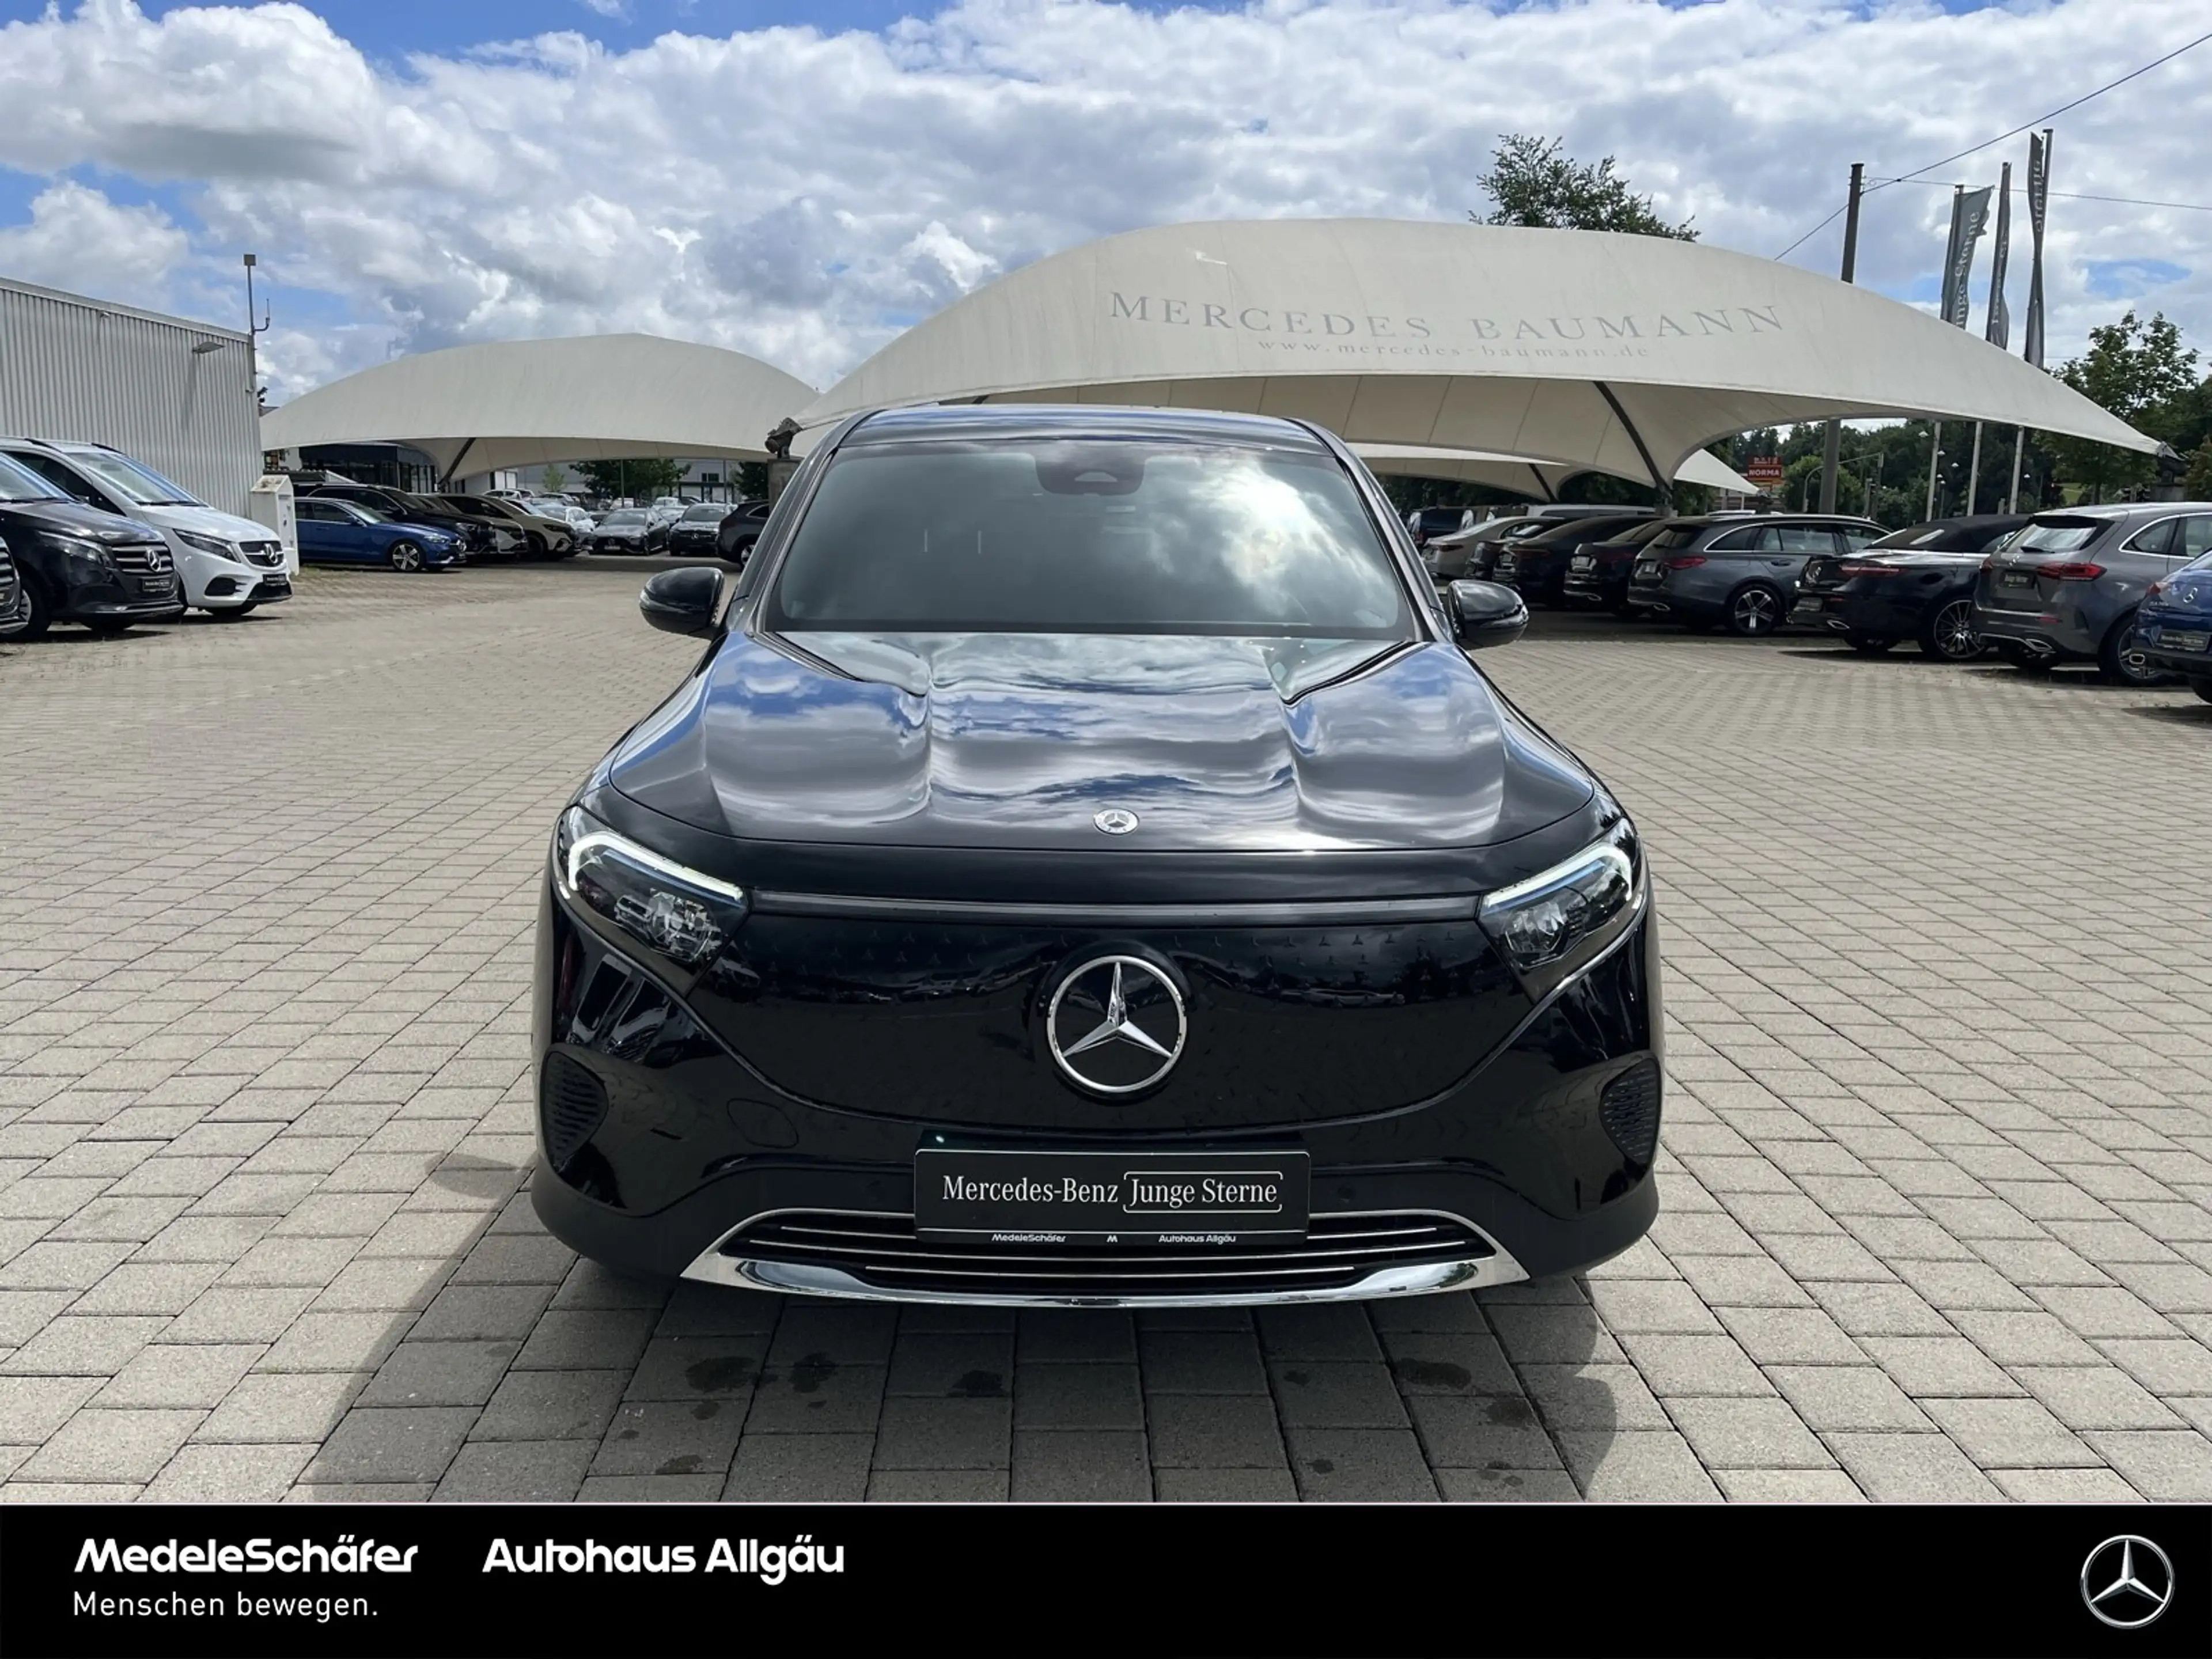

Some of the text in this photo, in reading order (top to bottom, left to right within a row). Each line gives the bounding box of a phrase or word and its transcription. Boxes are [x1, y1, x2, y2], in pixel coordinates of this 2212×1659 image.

[1110, 291, 1783, 340] MERCEDES BAUMANN
[1259, 340, 1649, 358] www.mercedes-baumann.de
[943, 1175, 1277, 1209] Mercedes-Benz Junge Sterne
[991, 1233, 1066, 1243] MedeleSchäfer
[1158, 1234, 1205, 1243] Autohaus
[1206, 1234, 1236, 1245] Allgäu
